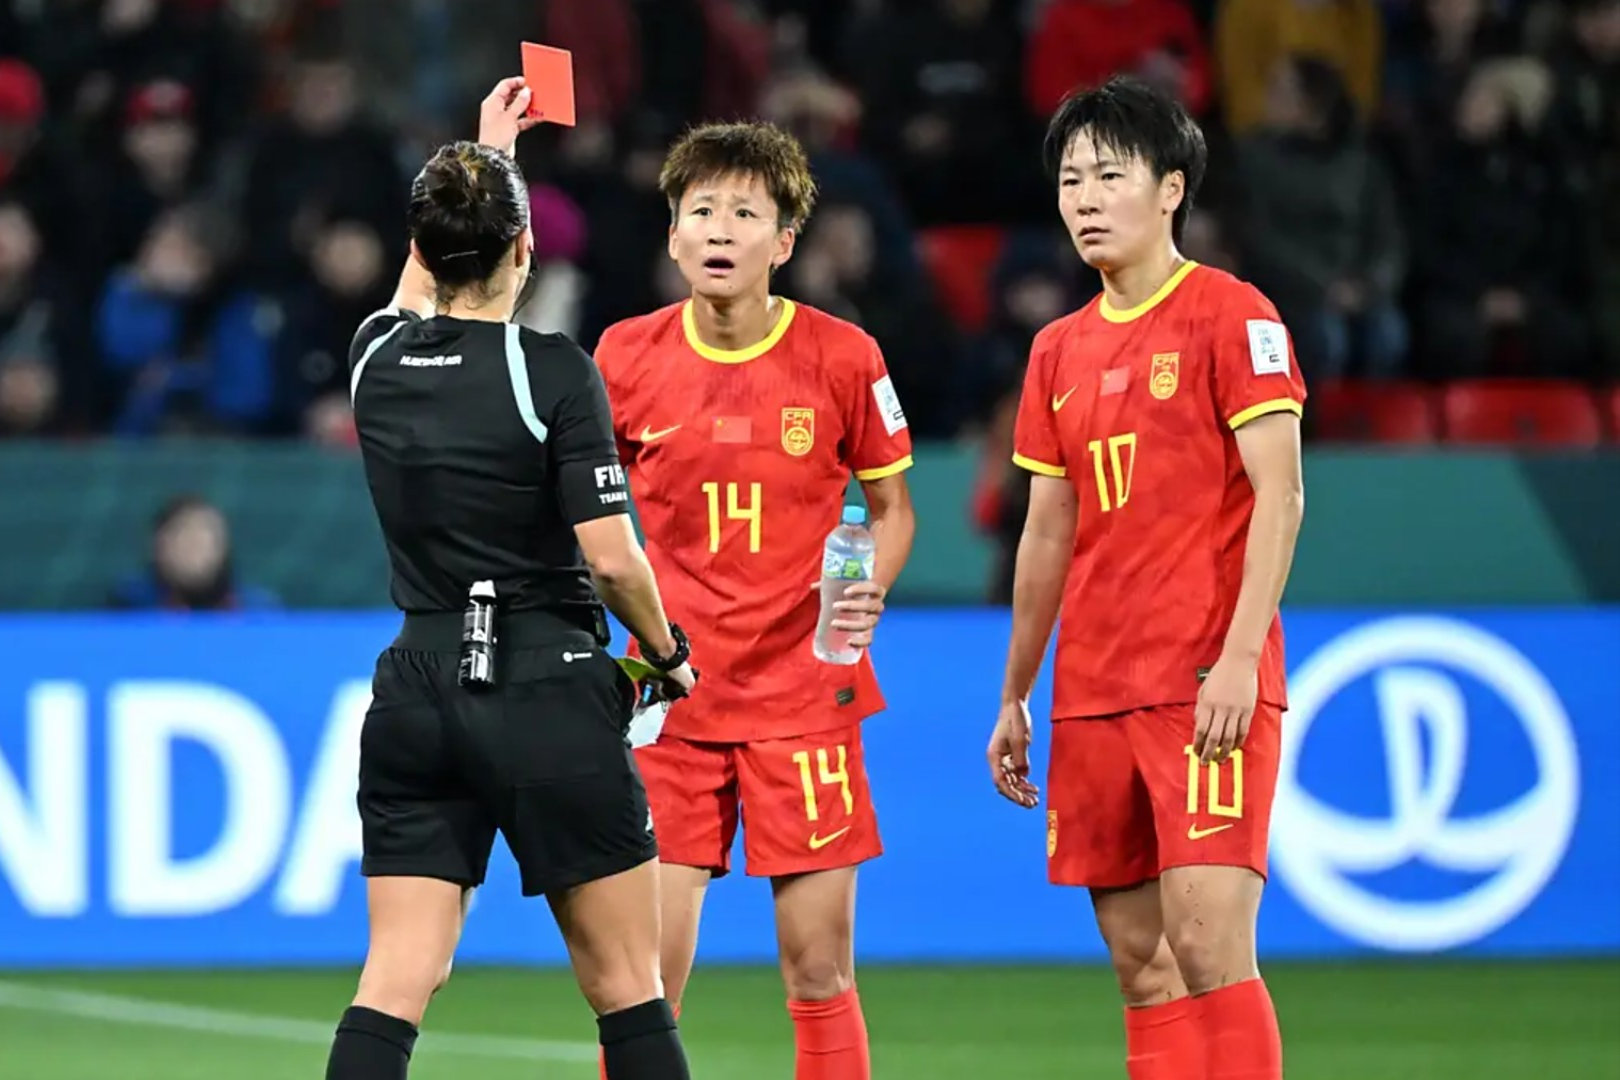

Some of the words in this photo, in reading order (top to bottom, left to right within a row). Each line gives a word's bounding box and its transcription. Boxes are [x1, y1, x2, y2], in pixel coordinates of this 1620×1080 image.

[1088, 433, 1137, 512] 10
[702, 482, 762, 553] 14
[792, 745, 853, 821] 14
[1184, 744, 1243, 818] 10
